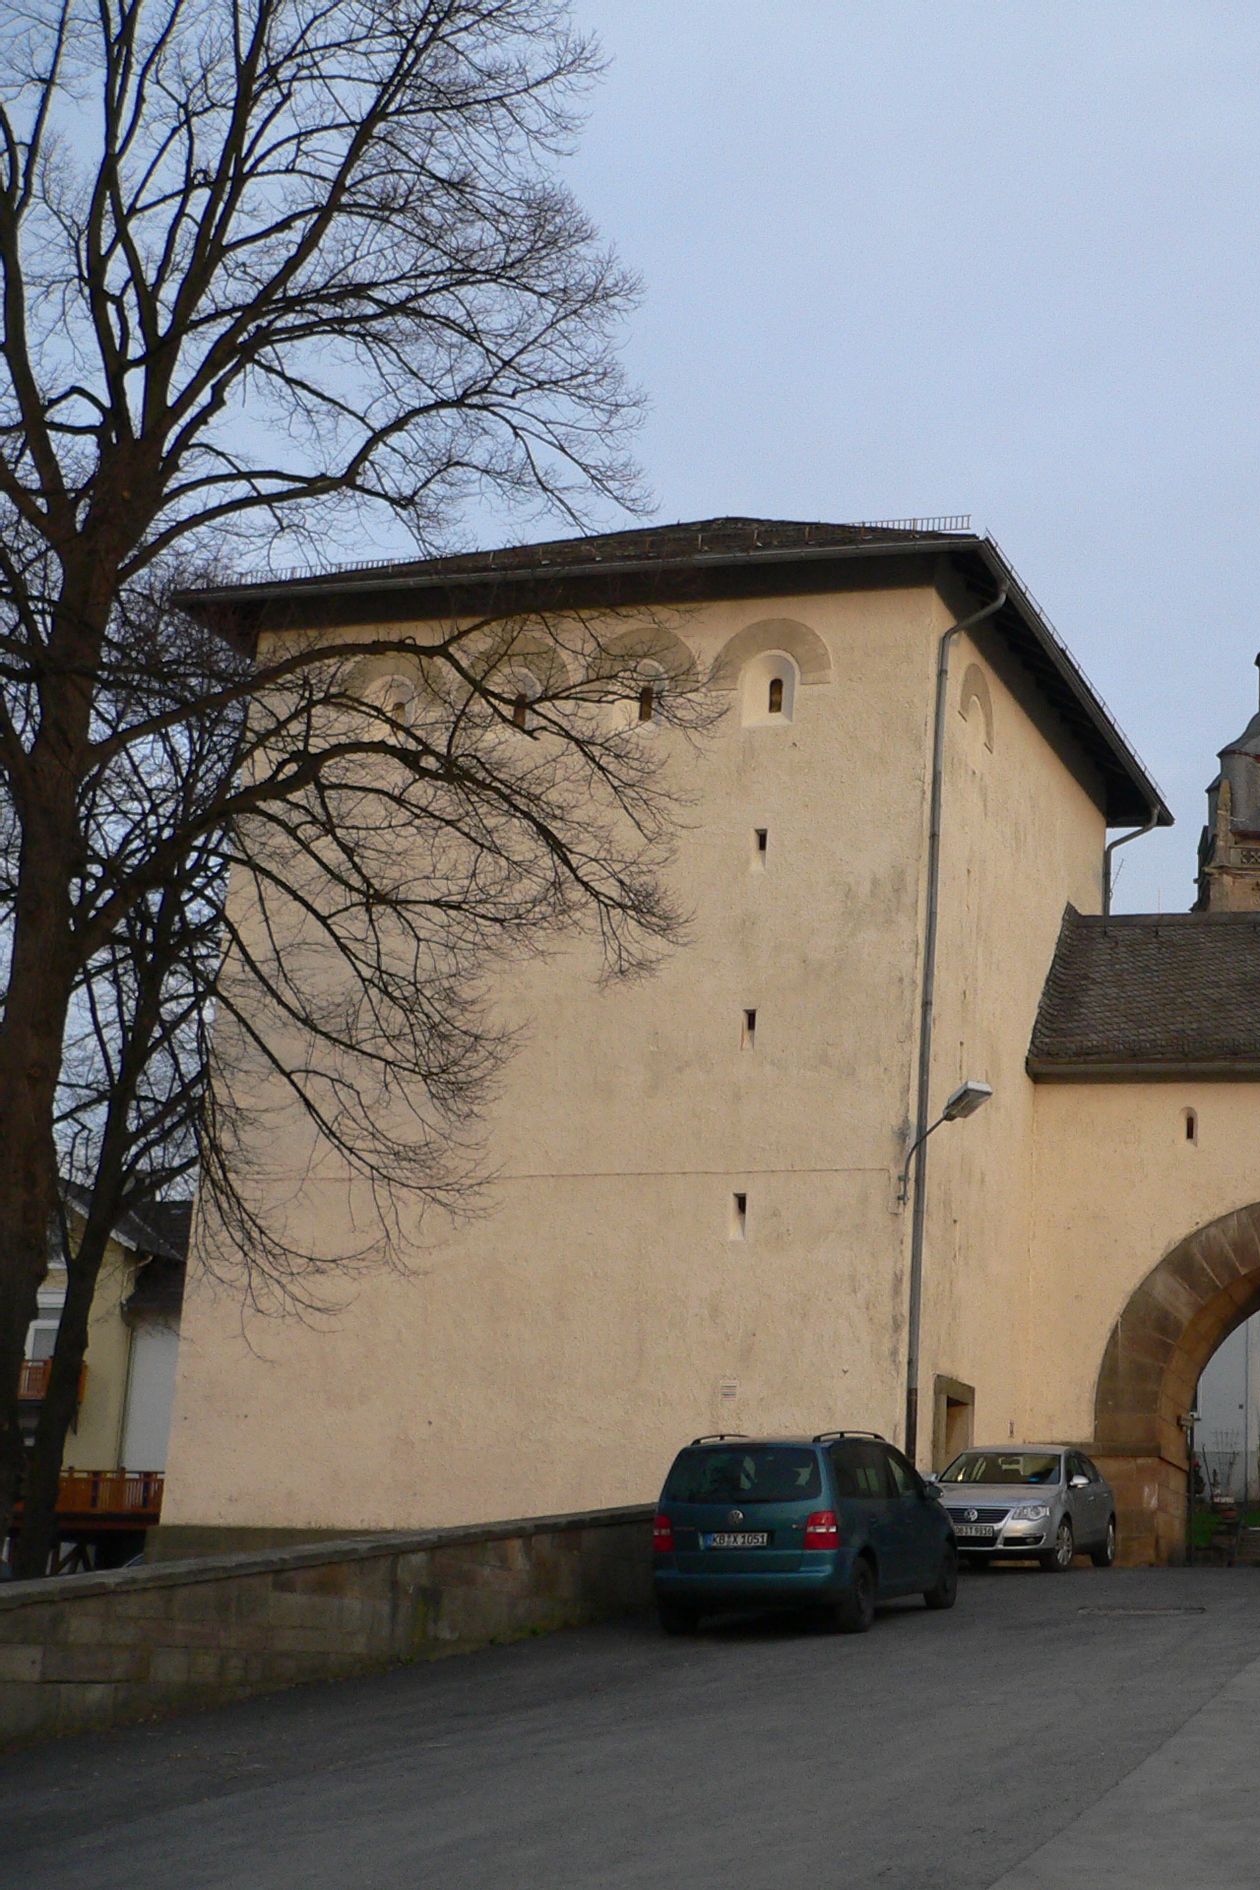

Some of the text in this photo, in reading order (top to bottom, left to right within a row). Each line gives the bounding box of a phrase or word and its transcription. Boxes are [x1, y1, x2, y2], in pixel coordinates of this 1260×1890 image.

[712, 1534, 765, 1545] KB X 1051
